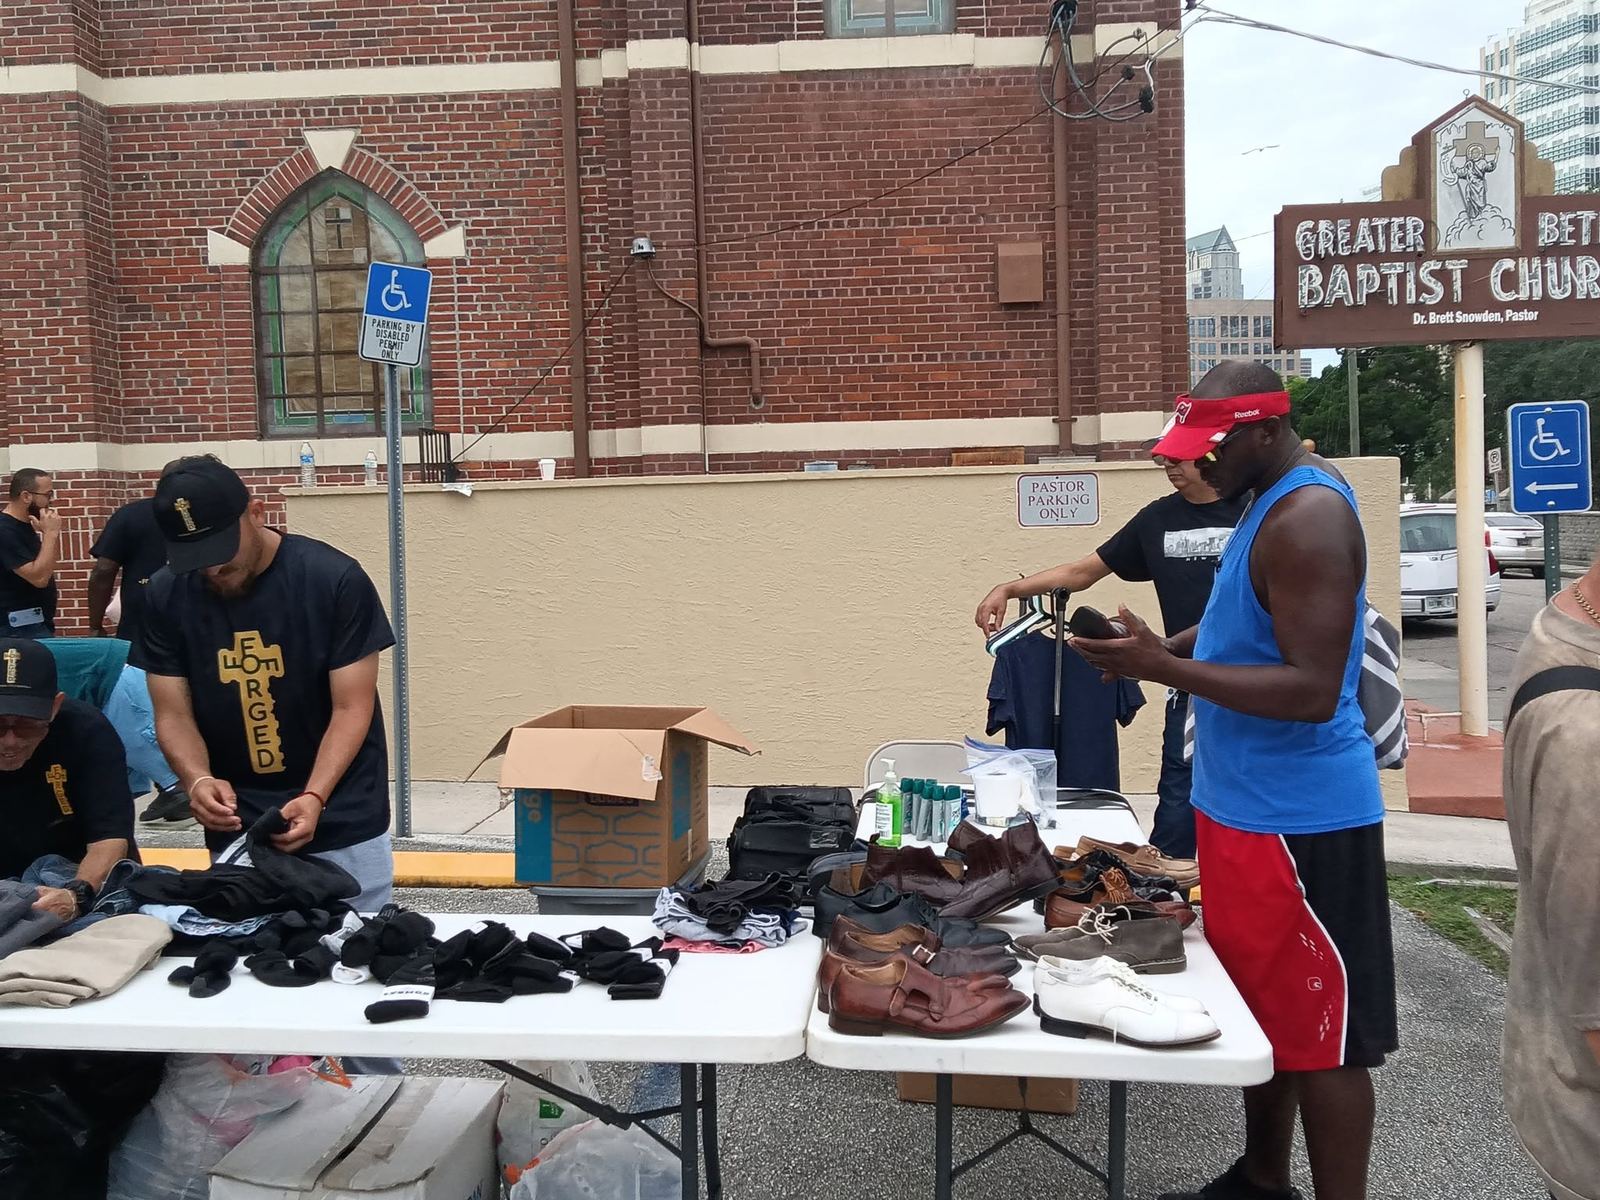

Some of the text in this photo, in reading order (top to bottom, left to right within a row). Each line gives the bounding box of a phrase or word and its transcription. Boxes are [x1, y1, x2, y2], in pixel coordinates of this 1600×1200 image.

[1295, 211, 1600, 259] GREATER BET
[1298, 255, 1600, 309] BAPTIST CHUR
[1413, 309, 1539, 324] Dr. Brett Snowden, Pastor
[372, 319, 416, 333] PARKING BY
[375, 329, 410, 342] DISABLED
[378, 339, 404, 351] PERMIT
[381, 349, 400, 360] ONLY
[1234, 408, 1261, 419] Reebok
[1032, 481, 1085, 493] PASTOR
[1028, 493, 1090, 506] PARKING
[1040, 507, 1079, 519] ONLY
